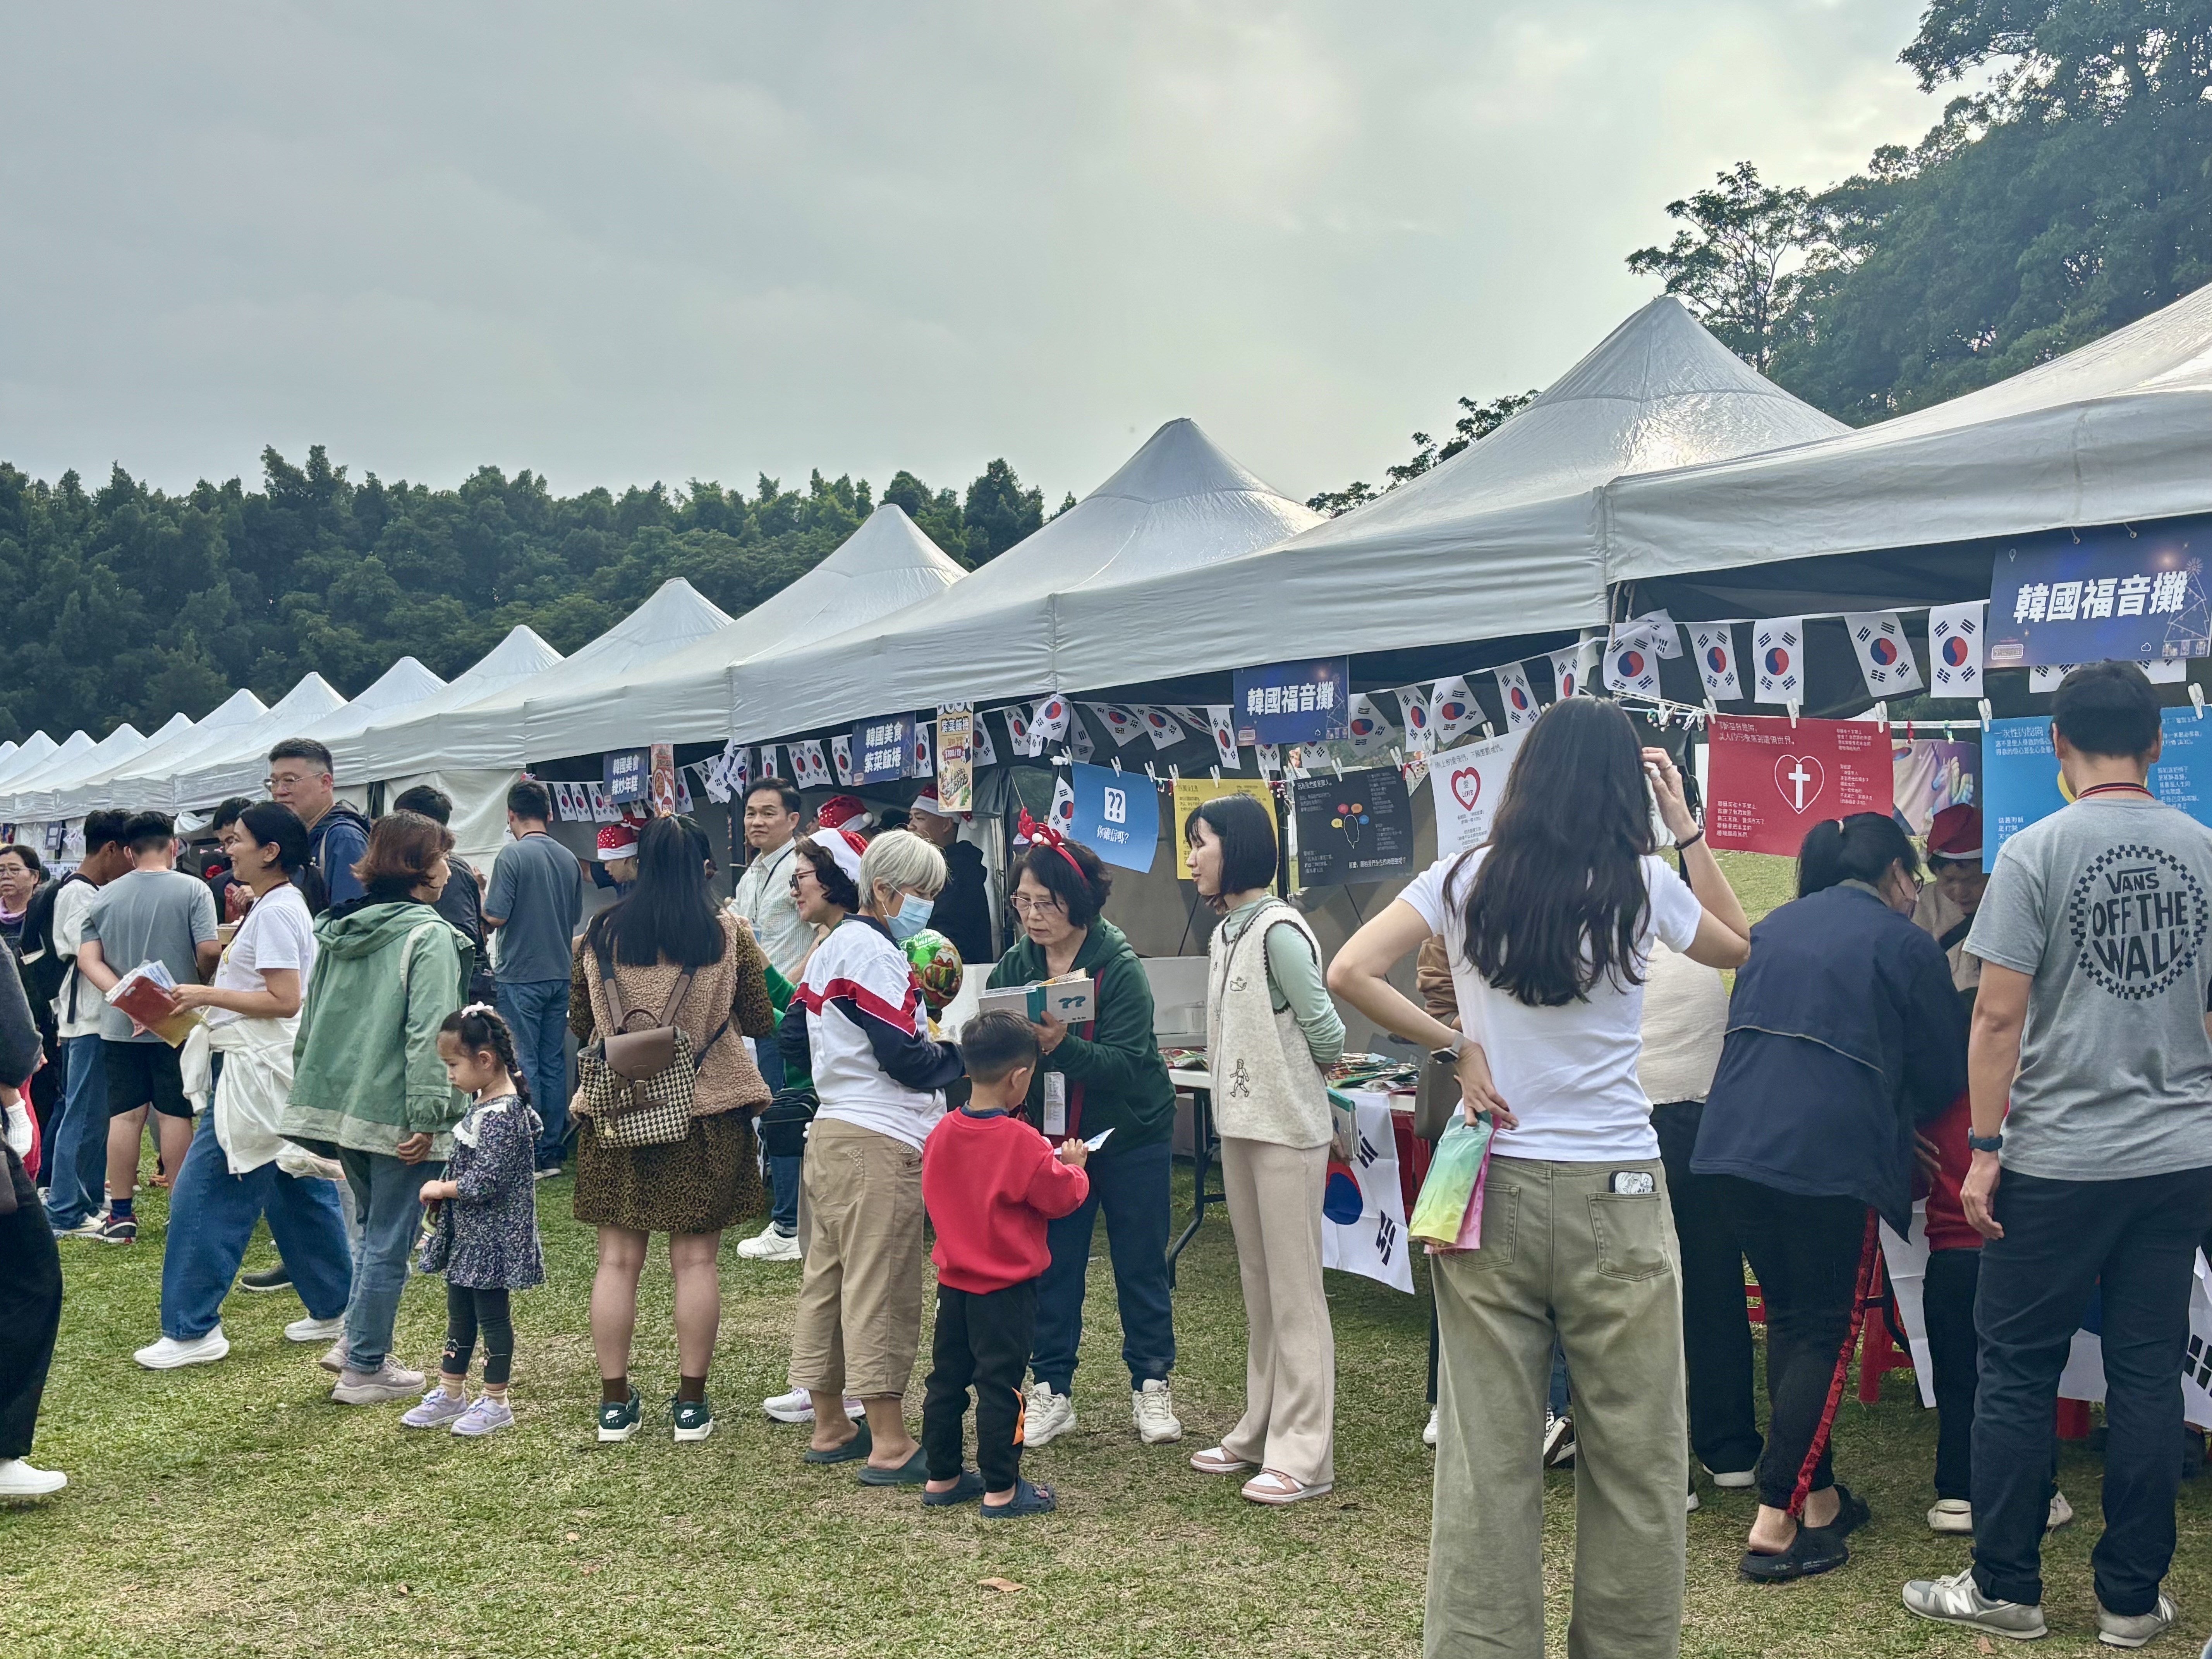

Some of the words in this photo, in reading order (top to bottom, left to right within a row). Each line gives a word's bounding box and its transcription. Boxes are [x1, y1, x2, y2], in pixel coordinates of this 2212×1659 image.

[2013, 571, 2187, 624] 韓國福音攤
[1247, 681, 1334, 716] 韓國福音攤
[866, 721, 903, 748] 韓國美食
[613, 754, 639, 775] 韓國美食
[864, 747, 902, 773] 紫菜飯捲
[612, 775, 638, 795] 辣炒年糕
[2105, 866, 2160, 895] VANS
[2136, 891, 2188, 931] THE
